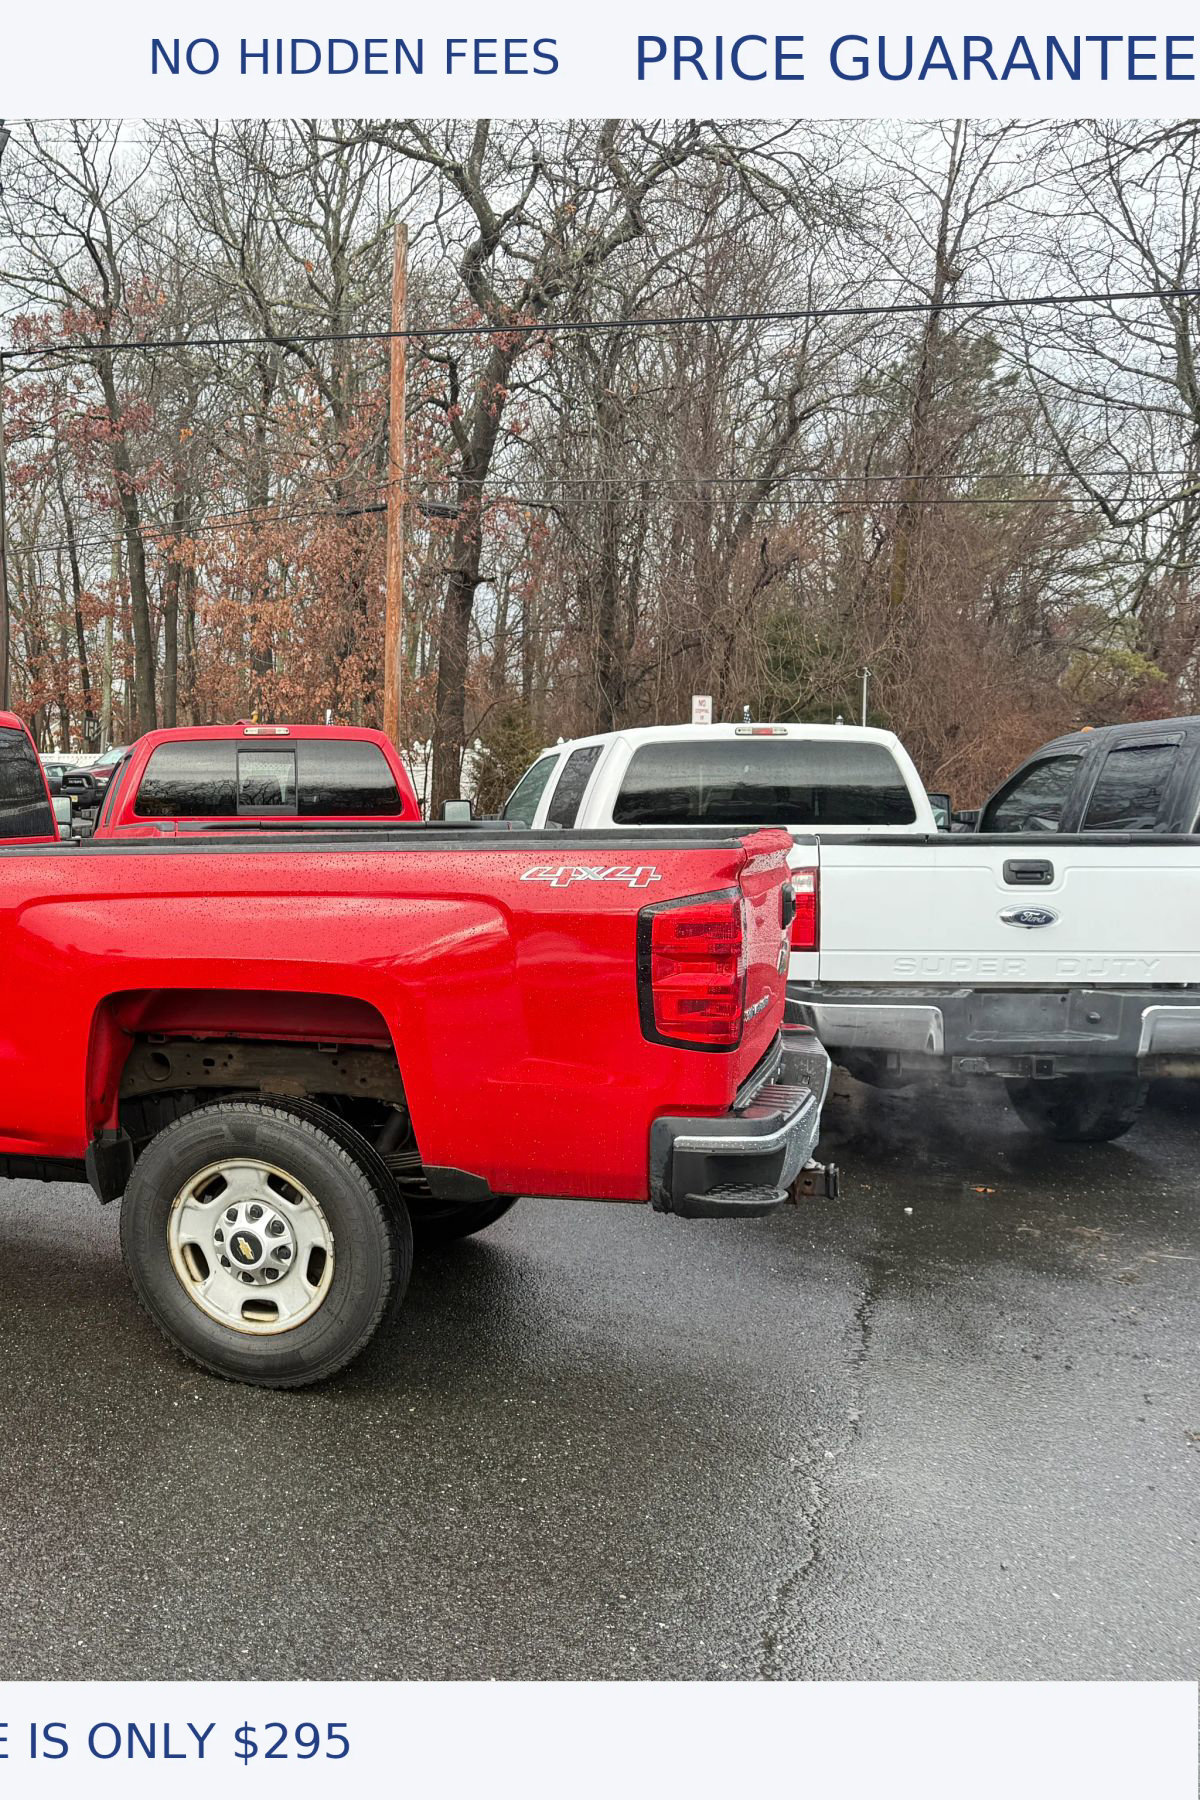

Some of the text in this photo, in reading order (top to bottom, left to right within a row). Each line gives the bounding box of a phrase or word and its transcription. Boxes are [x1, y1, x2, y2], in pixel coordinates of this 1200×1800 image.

[1020, 911, 1047, 923] Ford
[893, 957, 1161, 978] SUPER DUTY
